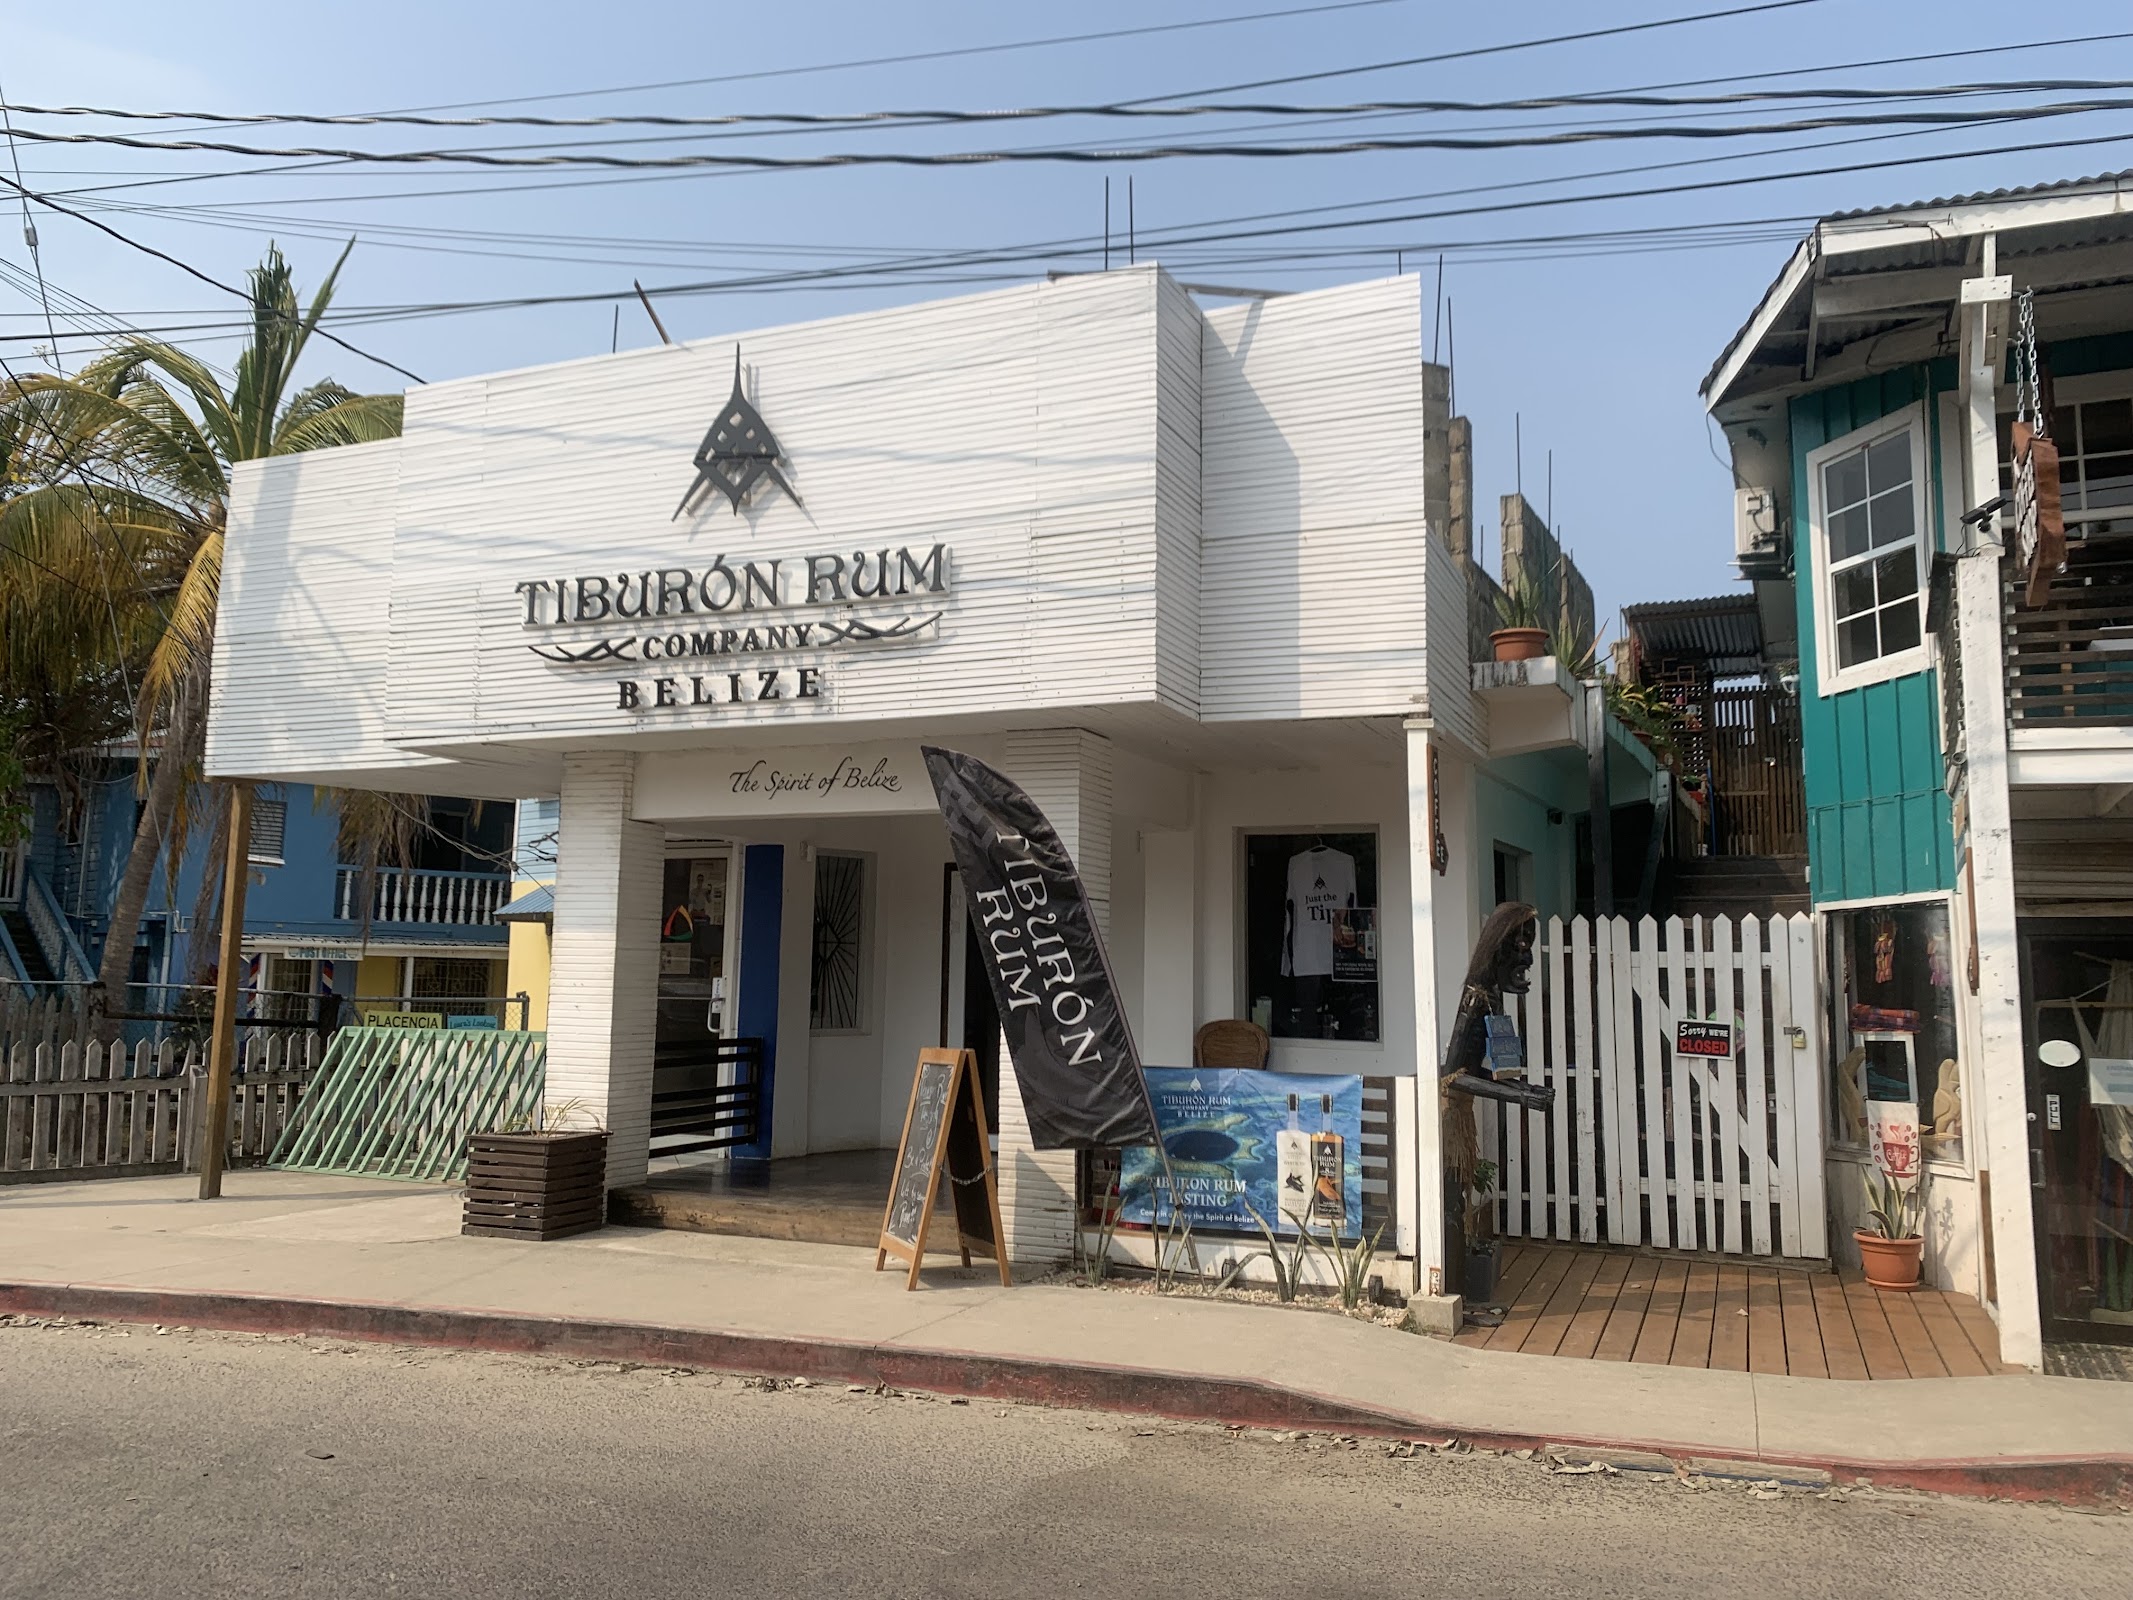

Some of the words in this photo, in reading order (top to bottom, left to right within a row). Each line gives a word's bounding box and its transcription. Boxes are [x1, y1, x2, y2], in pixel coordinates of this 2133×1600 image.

[515, 554, 782, 625] TIBURÓN
[804, 542, 946, 604] RUM
[642, 622, 815, 661] COMPANY
[616, 667, 820, 710] BELIZE
[729, 759, 767, 793] The
[764, 770, 814, 800] Spirit
[818, 756, 853, 797] of
[842, 757, 903, 793] Belize
[1433, 757, 1445, 863] COFFEE
[1305, 894, 1321, 904] Just
[1323, 893, 1337, 902] the
[299, 947, 320, 959] POST
[976, 885, 1042, 1012] RUM
[367, 1015, 439, 1029] PLACENCIA
[1679, 1023, 1707, 1037] Sorry
[1709, 1028, 1729, 1037] WE'RE
[1680, 1038, 1729, 1055] CLOSED
[1209, 1096, 1231, 1106] RUM
[1177, 1110, 1216, 1118] BELIZE
[2049, 1100, 2059, 1124] PULL
[1214, 1179, 1247, 1193] RUM
[1167, 1191, 1227, 1207] TSTING
[1160, 1210, 1168, 1218] in
[1206, 1213, 1224, 1222] Spirit
[1234, 1215, 1255, 1224] Belize
